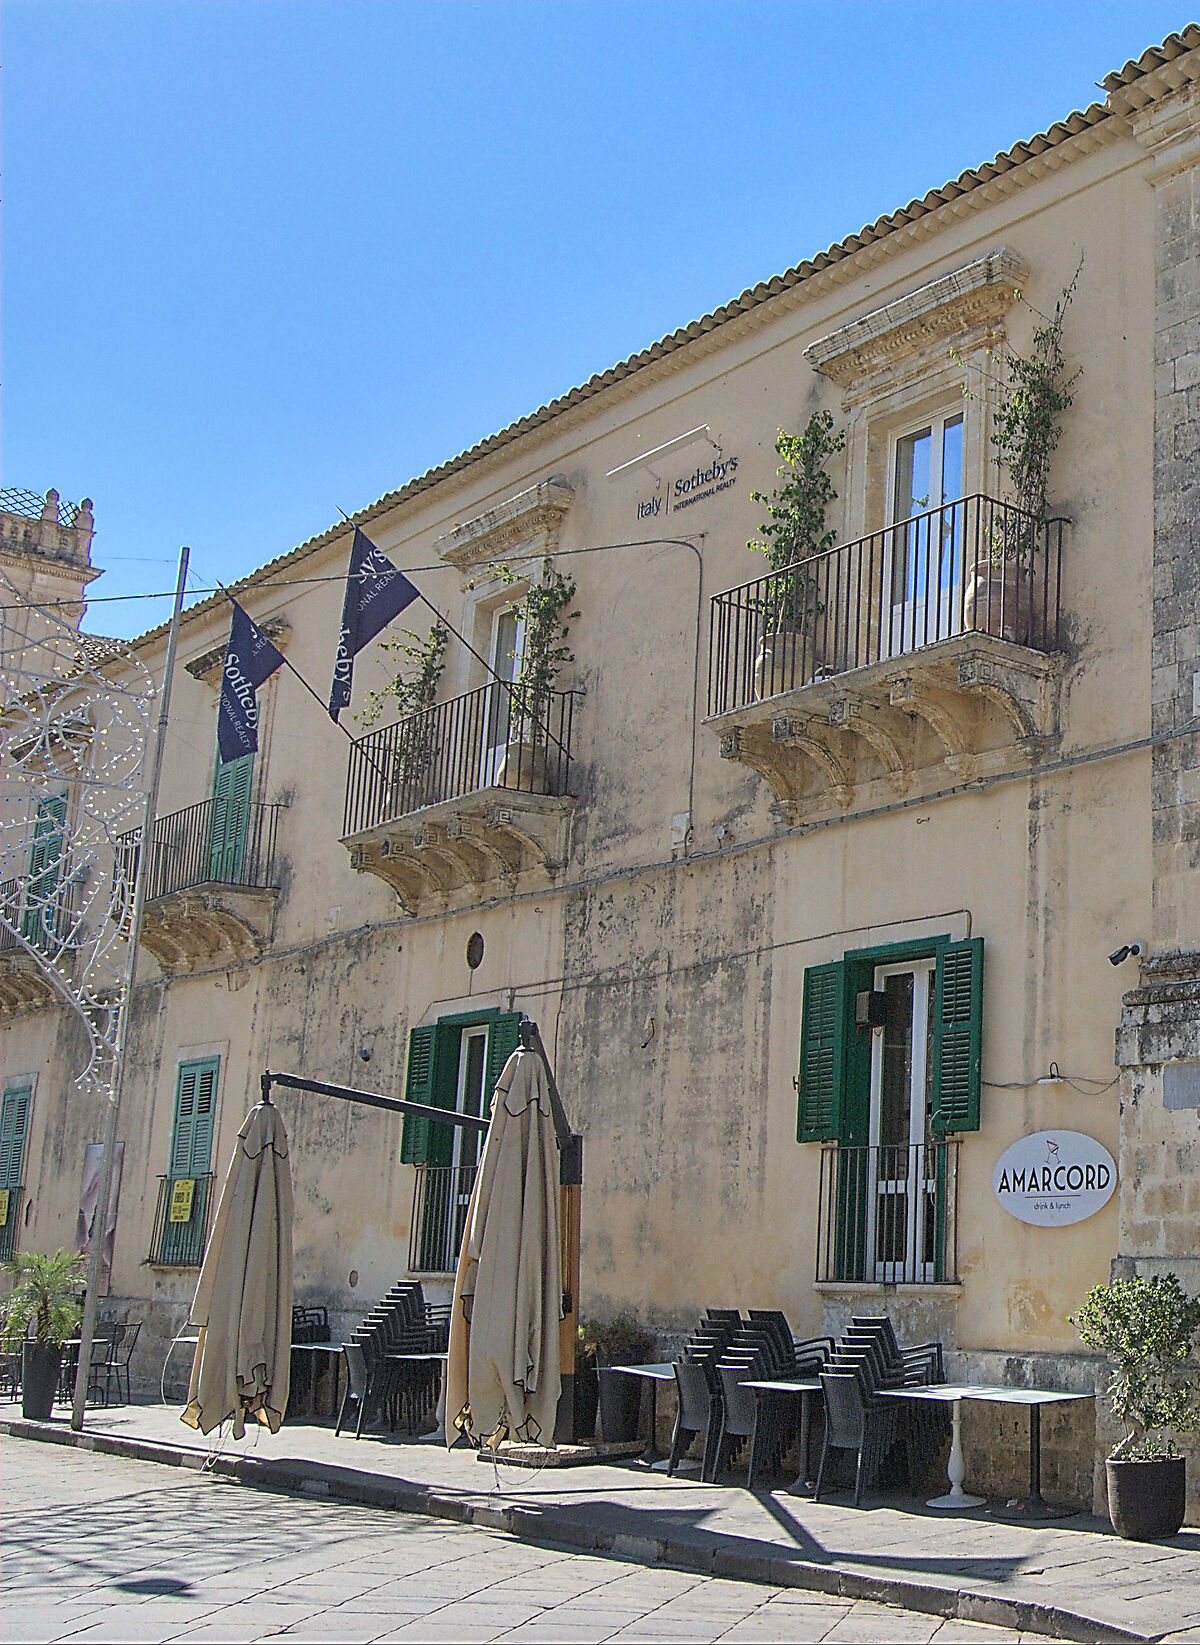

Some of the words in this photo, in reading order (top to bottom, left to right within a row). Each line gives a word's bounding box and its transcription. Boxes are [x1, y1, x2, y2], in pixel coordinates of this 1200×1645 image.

[637, 496, 662, 520] Italy
[674, 457, 738, 497] Sotheby's
[233, 720, 252, 749] REALTY
[998, 1164, 1110, 1193] AMARCORD
